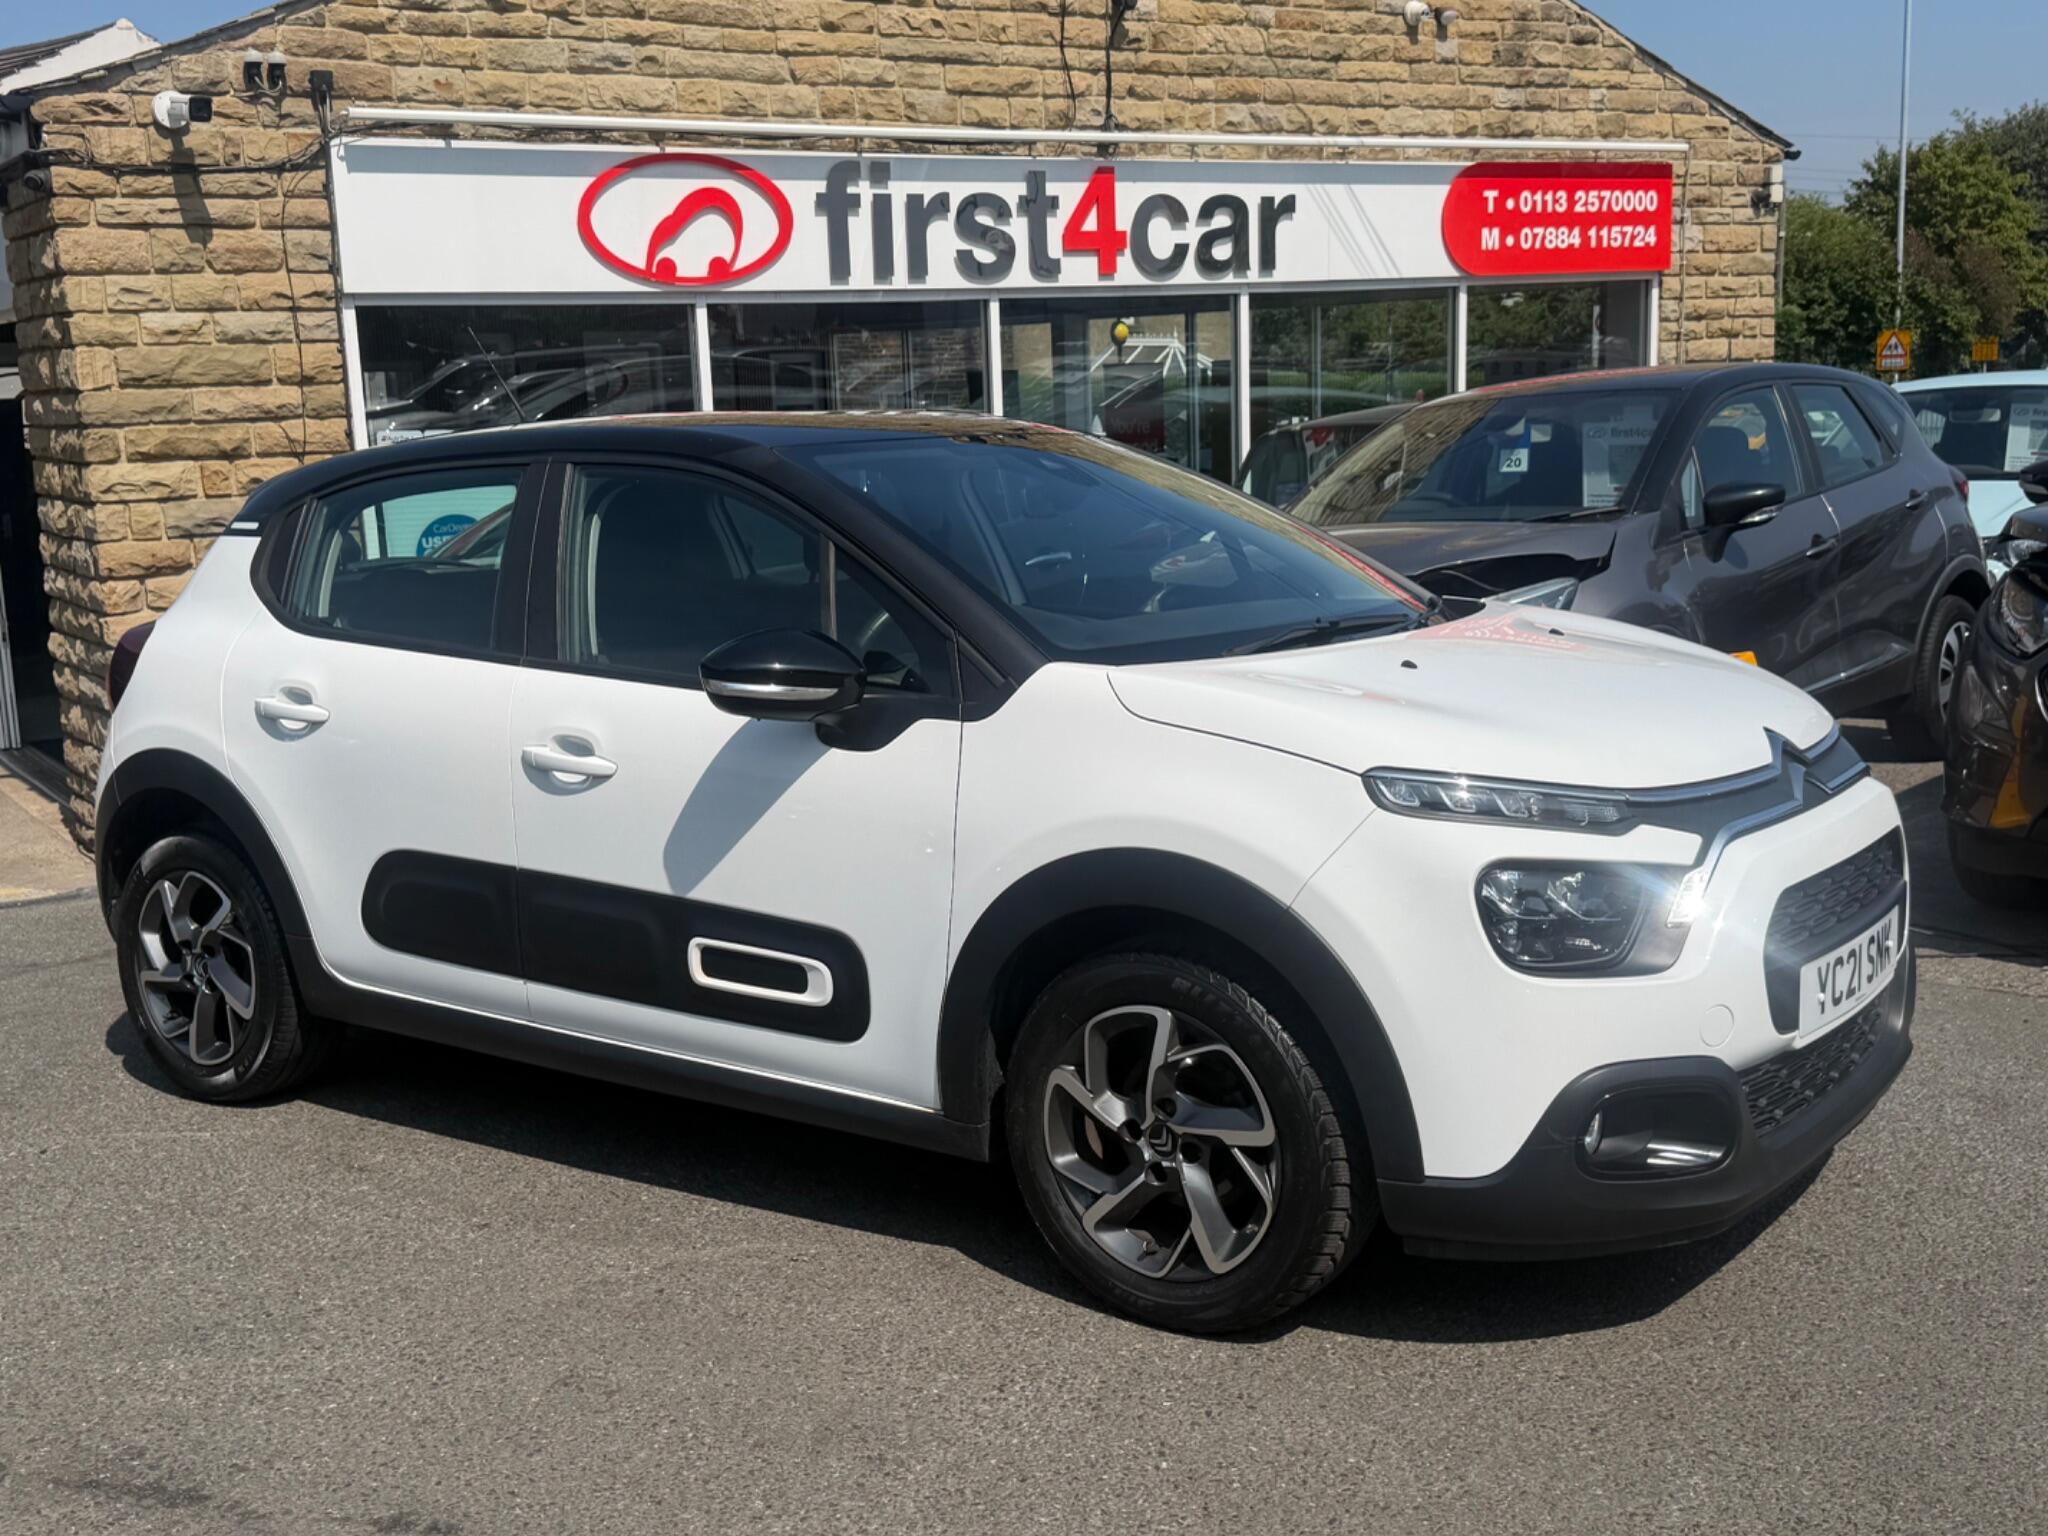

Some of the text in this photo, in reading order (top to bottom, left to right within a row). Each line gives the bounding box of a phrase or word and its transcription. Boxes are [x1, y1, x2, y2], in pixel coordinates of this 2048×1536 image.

[1482, 190, 1658, 213] T 0113 2570000
[815, 160, 1296, 284] first4car
[1480, 225, 1657, 250] M 07884 115724
[1505, 457, 1522, 468] 20
[1818, 919, 1891, 1014] YC21 SNK
